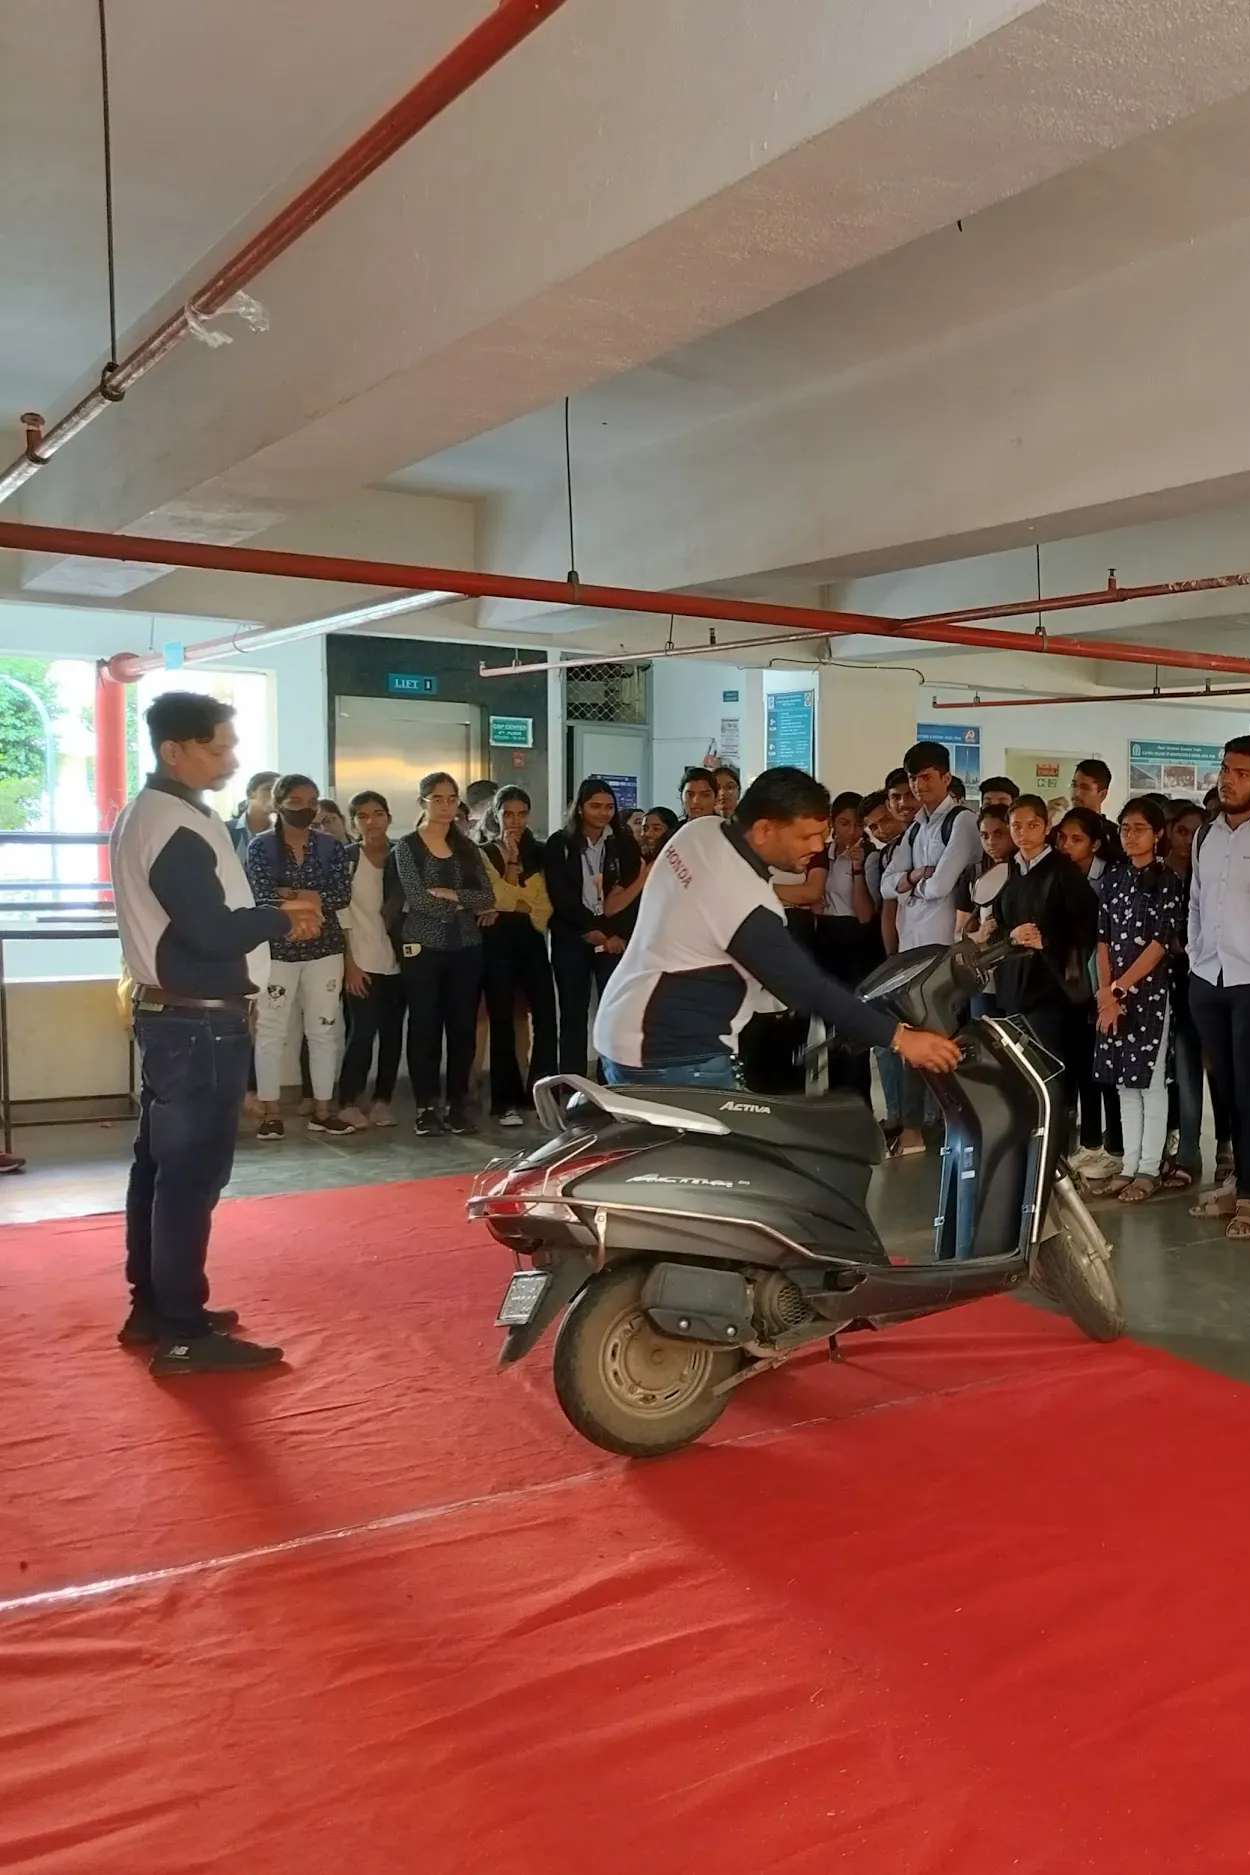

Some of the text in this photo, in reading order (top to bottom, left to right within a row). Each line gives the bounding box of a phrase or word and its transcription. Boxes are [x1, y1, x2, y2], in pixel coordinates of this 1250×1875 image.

[394, 678, 420, 690] LIFT
[665, 844, 692, 889] HONDA
[719, 1101, 771, 1114] ACTIVA
